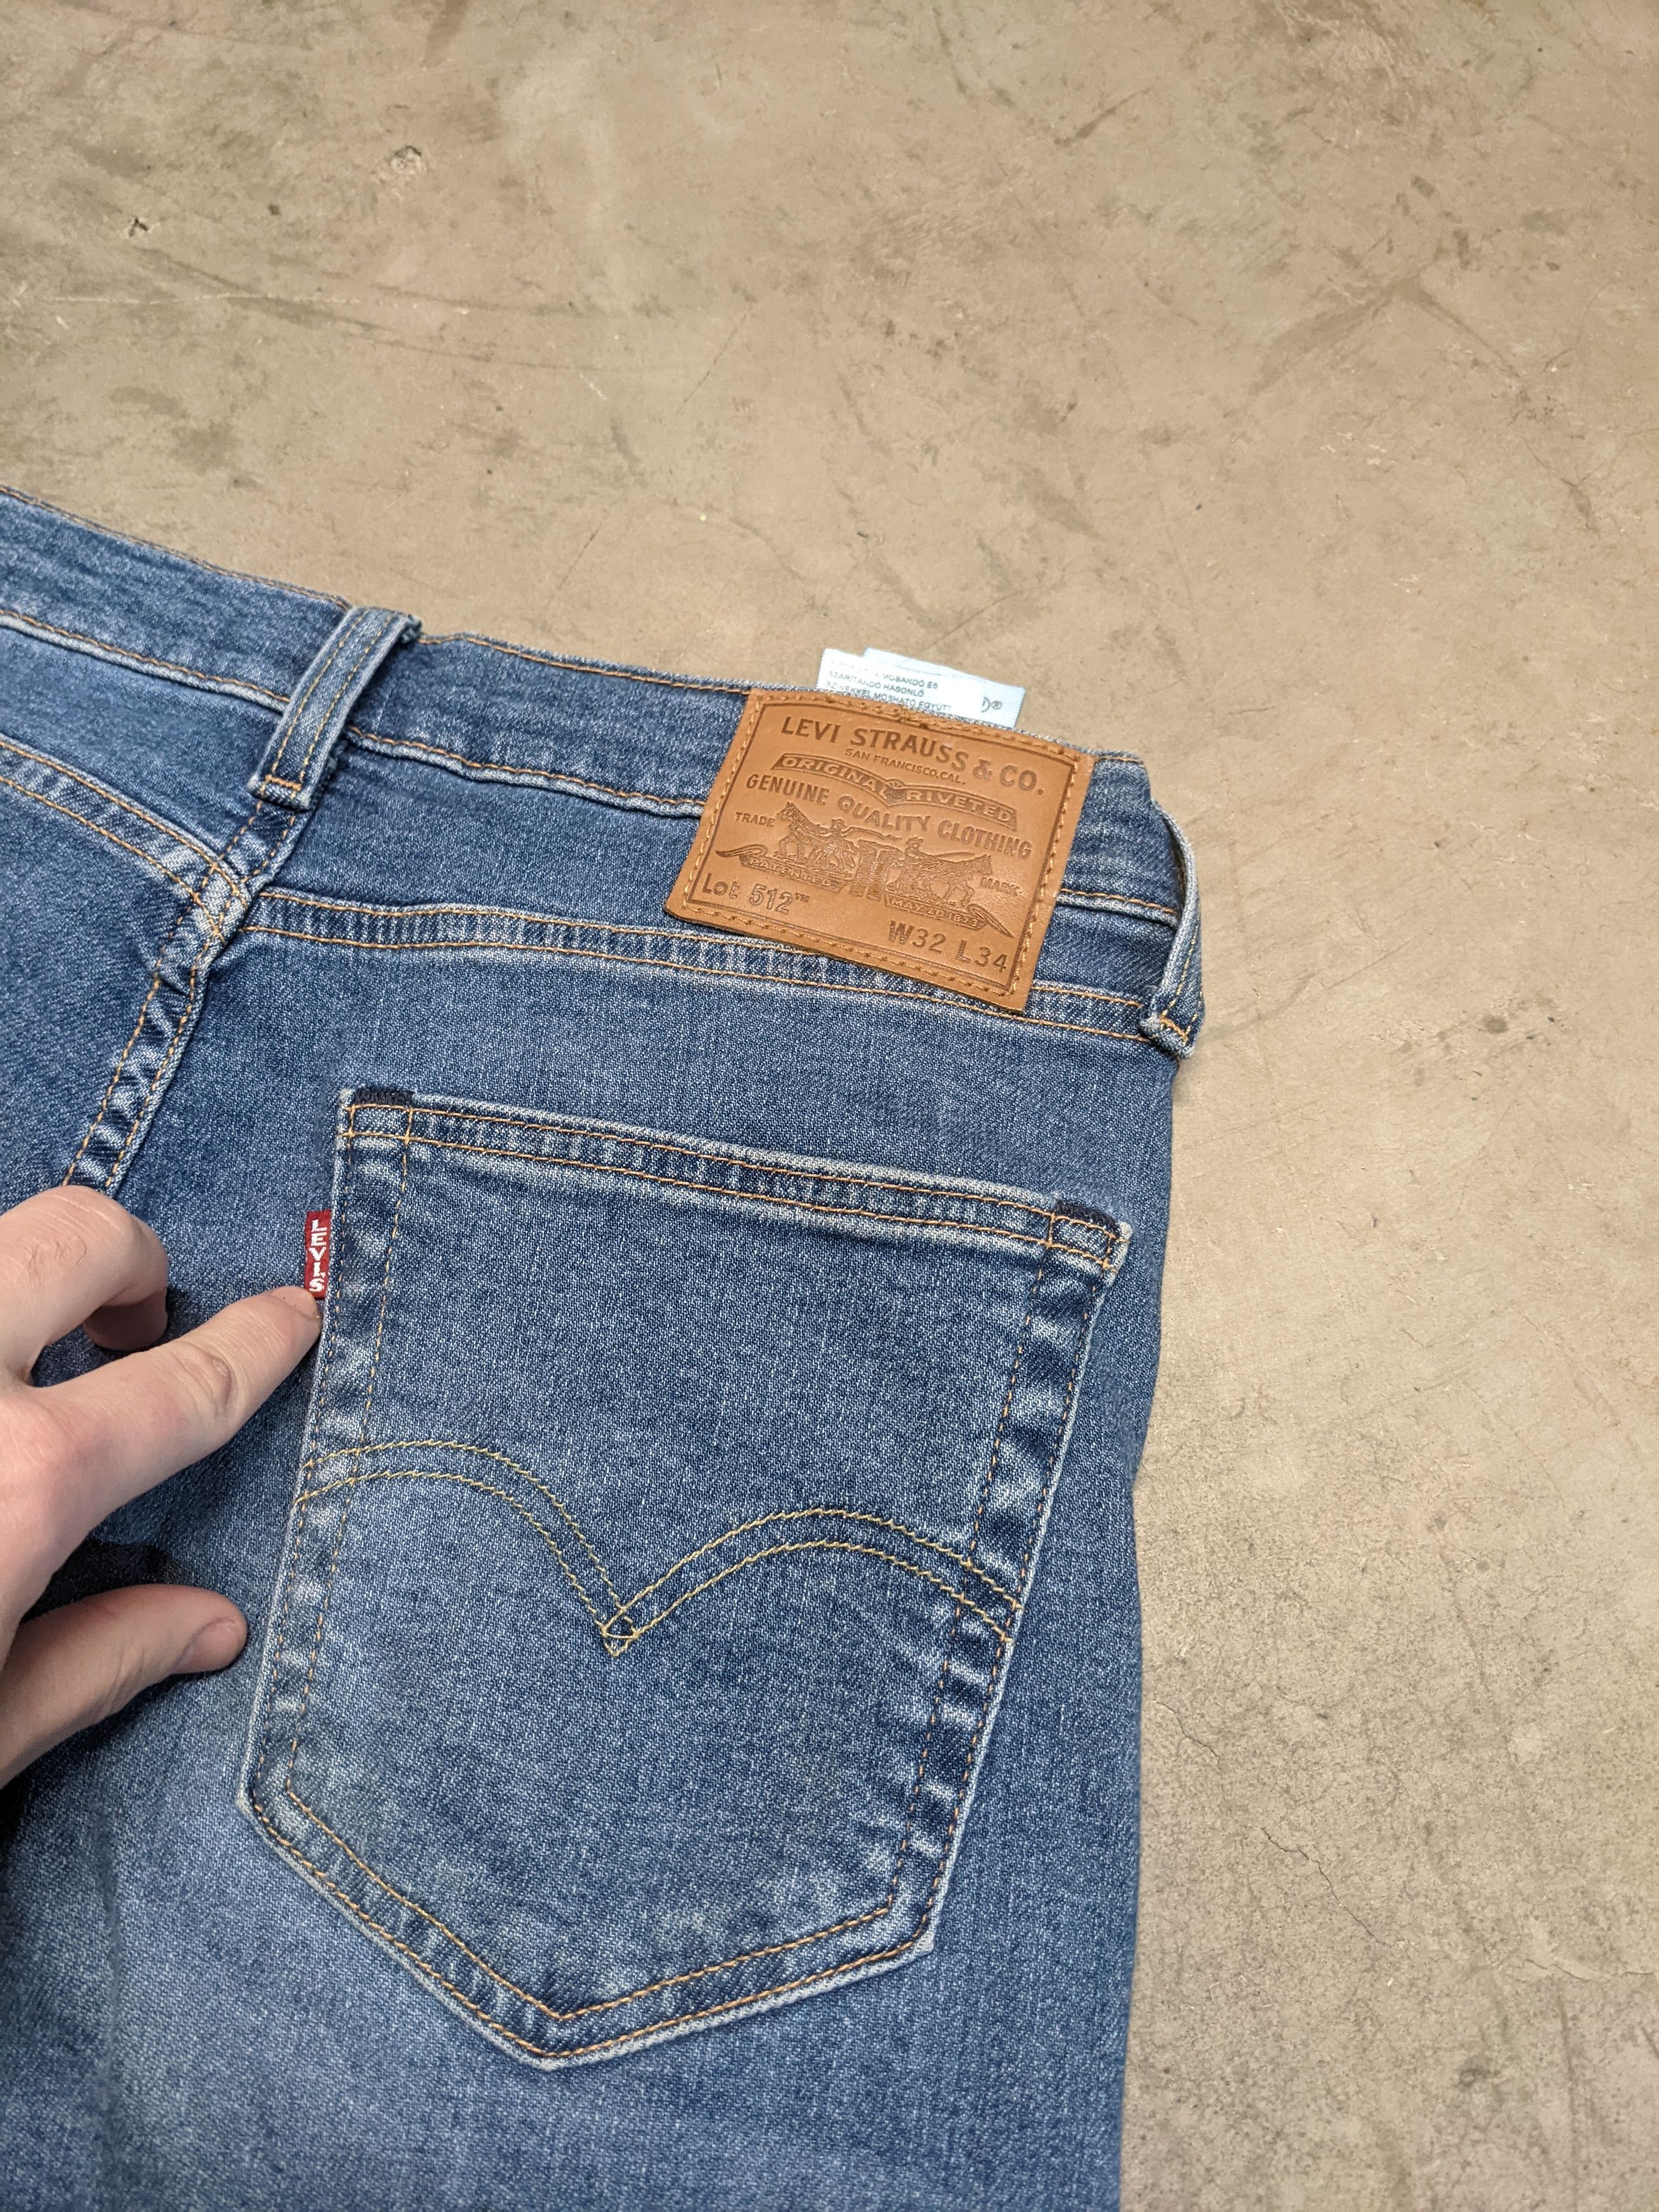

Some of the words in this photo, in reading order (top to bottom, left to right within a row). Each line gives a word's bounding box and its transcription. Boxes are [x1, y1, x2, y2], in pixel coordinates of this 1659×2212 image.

[927, 681, 939, 690] ÉS
[781, 717, 841, 743] LEVI
[851, 728, 969, 772] STRAUSS
[973, 758, 992, 781] &
[1000, 765, 1043, 795] CO.
[845, 748, 870, 760] SAN
[782, 757, 887, 799] ORIGINAL
[906, 790, 1012, 822] RIVETED
[735, 811, 775, 827] TRADE
[746, 774, 830, 806] GENUINE
[838, 796, 930, 832] QUALITY
[938, 820, 1032, 860] CLOTHING
[749, 859, 832, 886] PATENTED
[702, 873, 740, 899] Lot
[890, 898, 923, 912] MAY
[889, 919, 946, 954] W32
[956, 939, 1008, 973] L34
